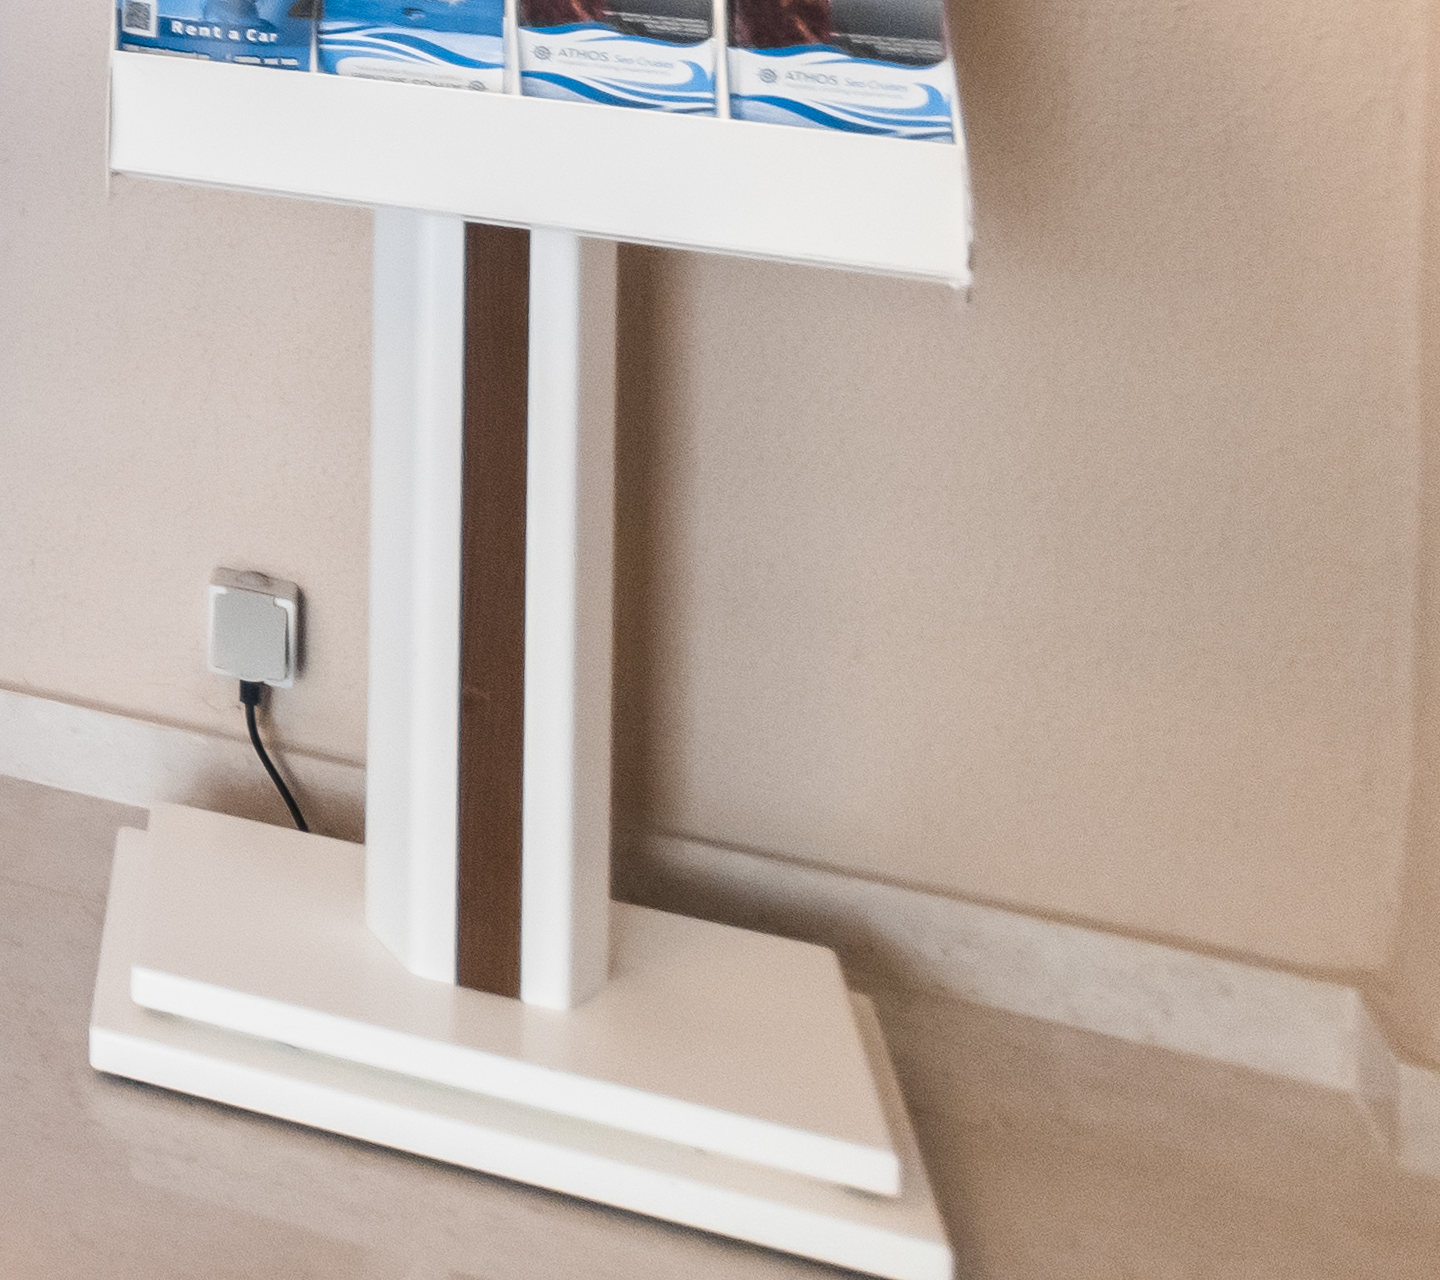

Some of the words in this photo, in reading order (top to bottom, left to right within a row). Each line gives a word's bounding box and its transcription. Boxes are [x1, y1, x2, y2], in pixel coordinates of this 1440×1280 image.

[170, 20, 221, 42] Rent
[228, 28, 240, 41] a
[245, 28, 278, 44] Car
